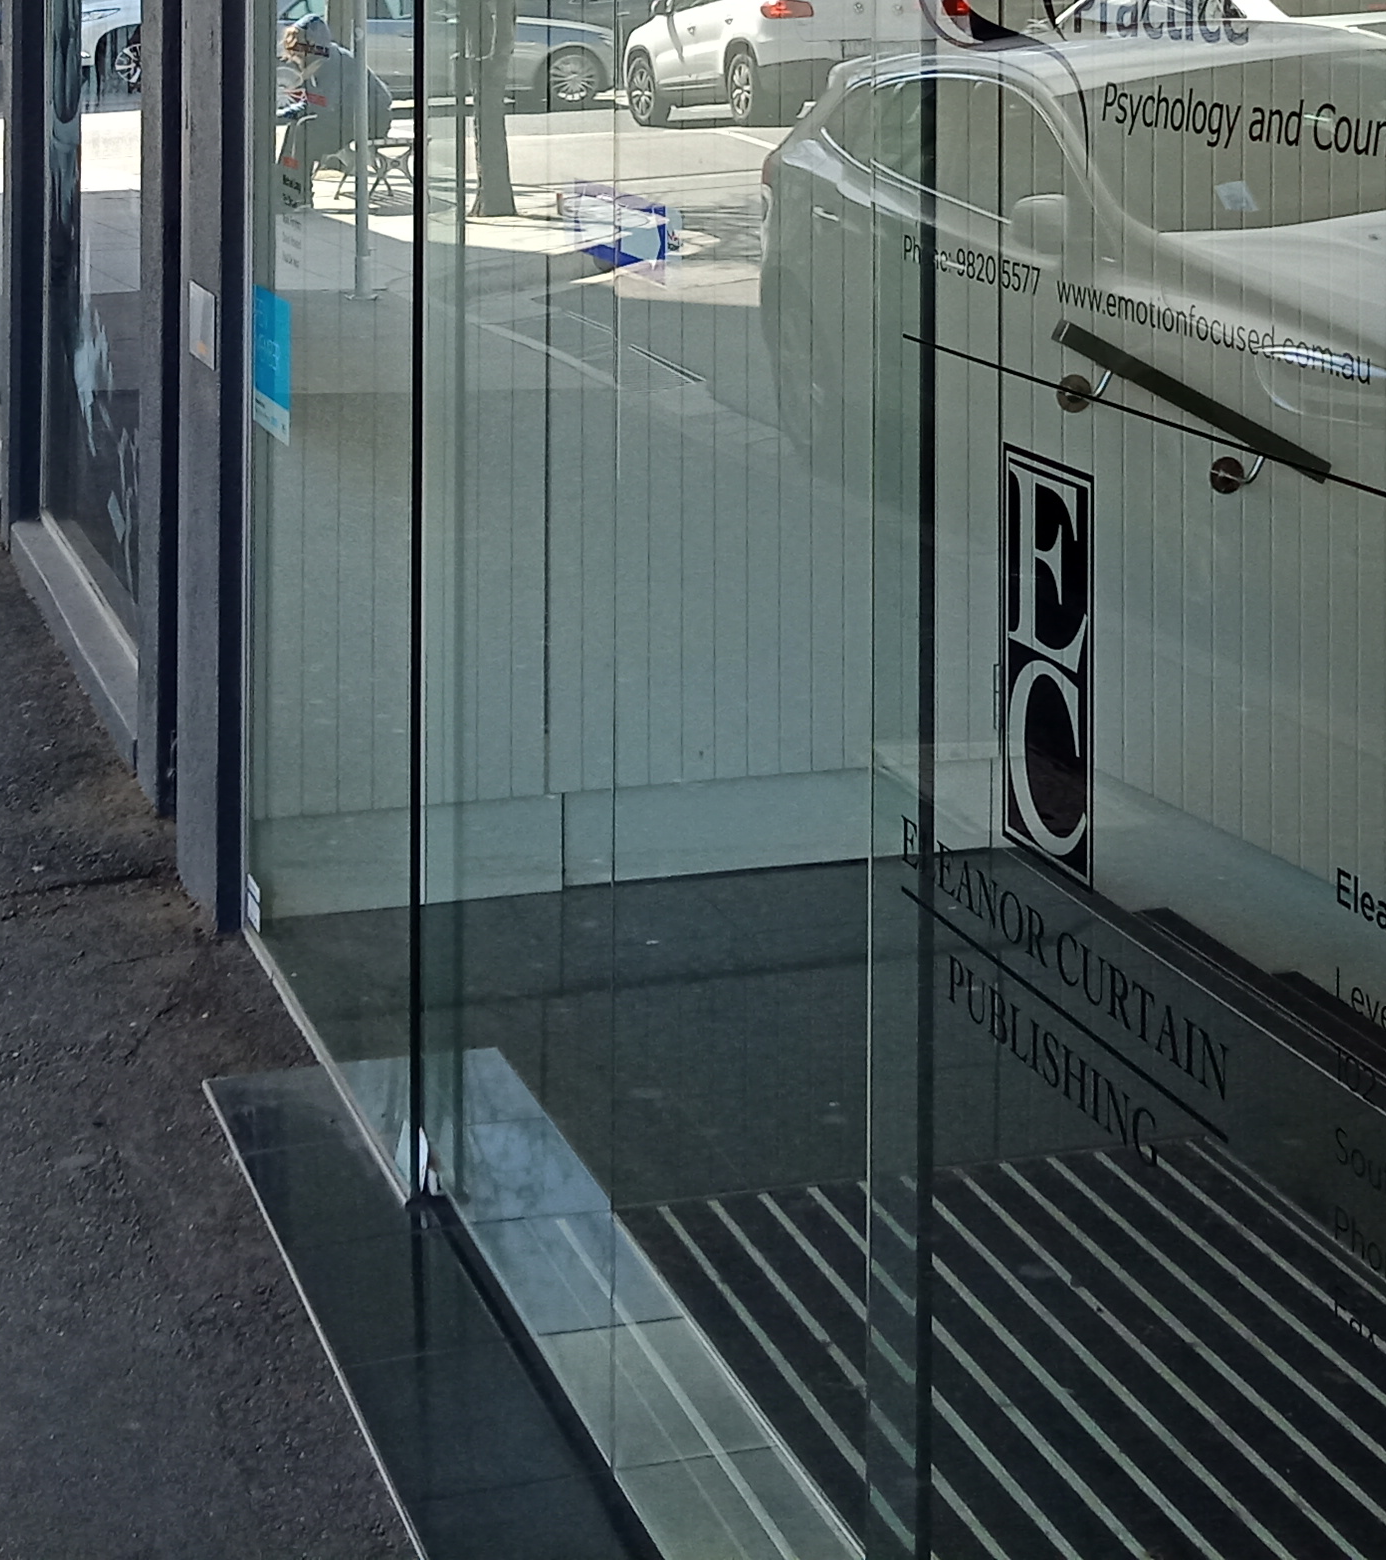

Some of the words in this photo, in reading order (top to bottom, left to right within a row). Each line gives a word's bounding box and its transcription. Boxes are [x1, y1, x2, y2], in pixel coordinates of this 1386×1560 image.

[1102, 81, 1242, 149] Psychology
[1248, 98, 1305, 147] and
[903, 234, 952, 273] Phne:
[956, 247, 997, 286] 9820
[1000, 258, 1042, 297] 5577
[1055, 278, 1373, 386] www.emotionfocused.com.au
[901, 813, 1048, 969] EEANOR
[1056, 931, 1231, 1103] CURTAIN
[947, 953, 1159, 1168] PUBLISHING
[1334, 1046, 1379, 1110] 102
